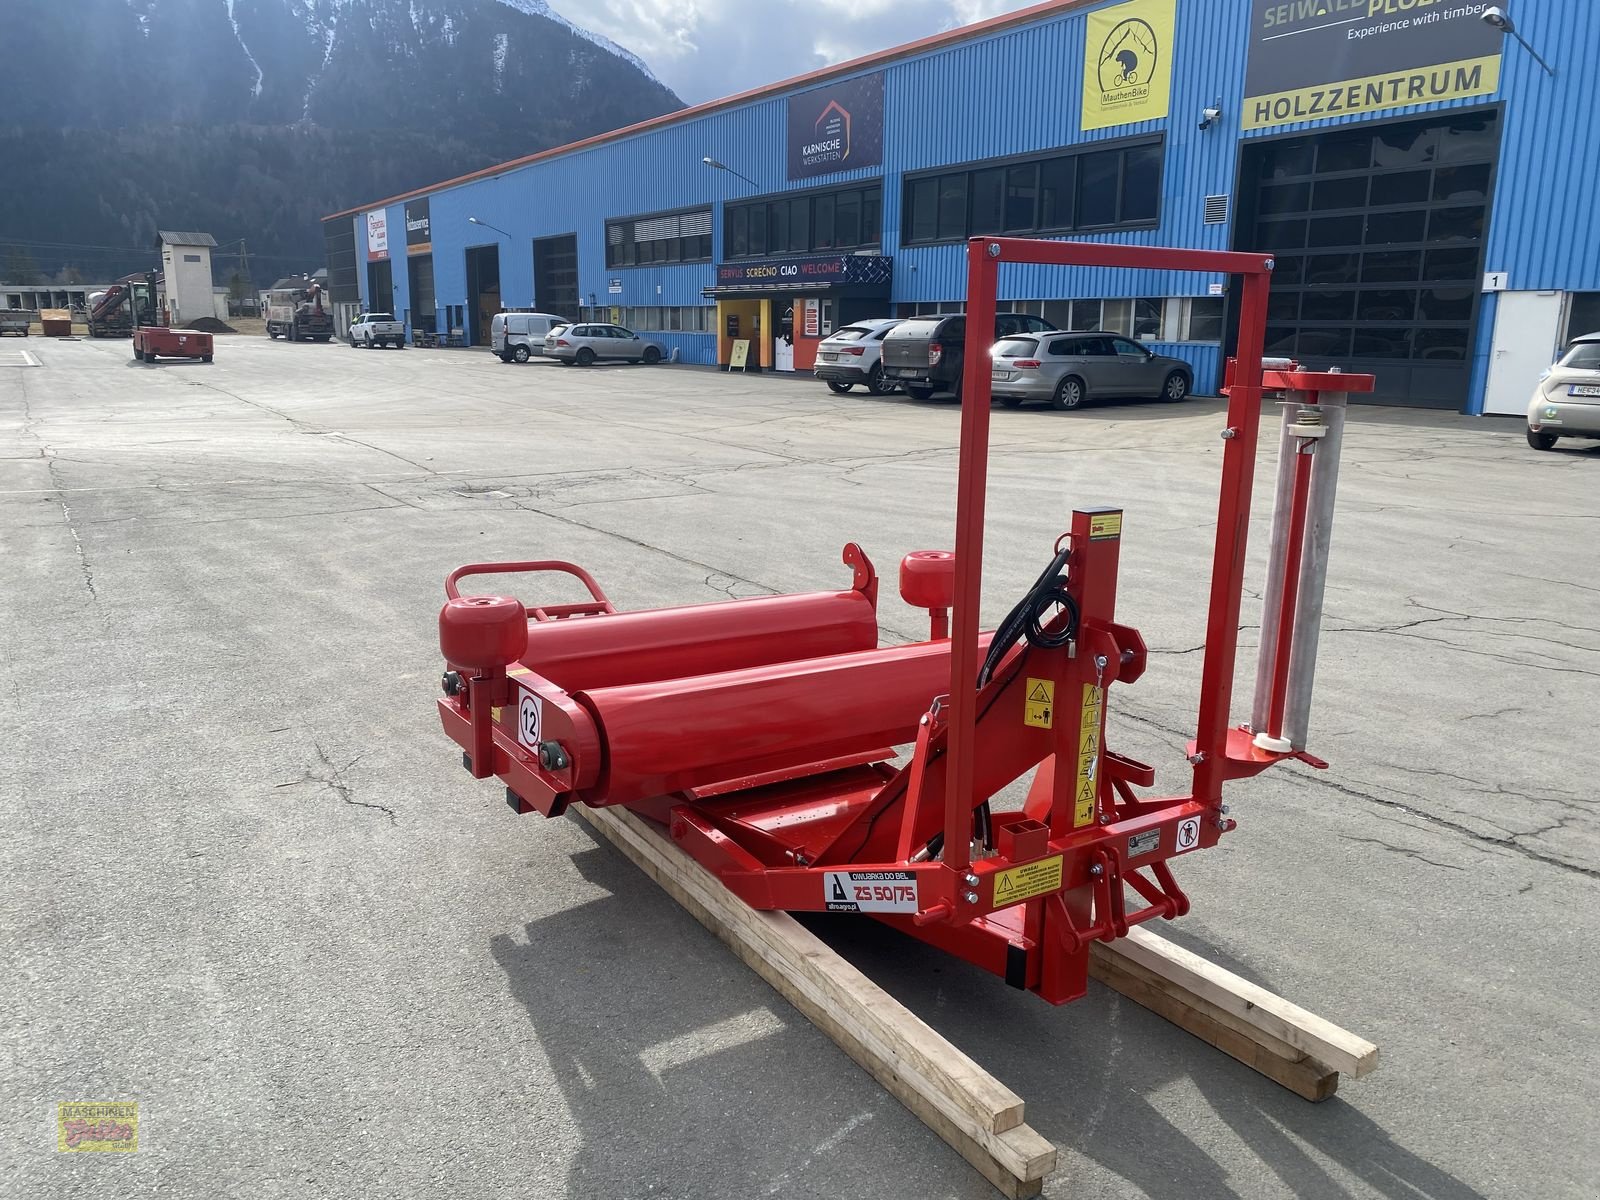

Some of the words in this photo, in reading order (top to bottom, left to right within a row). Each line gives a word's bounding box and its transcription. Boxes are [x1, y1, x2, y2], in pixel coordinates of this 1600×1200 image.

[1347, 19, 1410, 40] Experience
[1413, 12, 1440, 26] with
[1444, 3, 1487, 20] timber
[1103, 88, 1147, 102] MauthenBike
[1255, 64, 1482, 123] HOLZZENTRUM
[802, 138, 840, 155] KARNISCHE
[720, 268, 743, 279] SERVUS
[780, 265, 798, 276] CIAO
[801, 262, 840, 274] WELCOME
[1492, 275, 1498, 287] 1
[523, 707, 537, 737] 12
[885, 872, 895, 880] DO
[895, 872, 909, 880] BEL
[853, 886, 873, 901] ZS
[873, 885, 916, 904] 50/75
